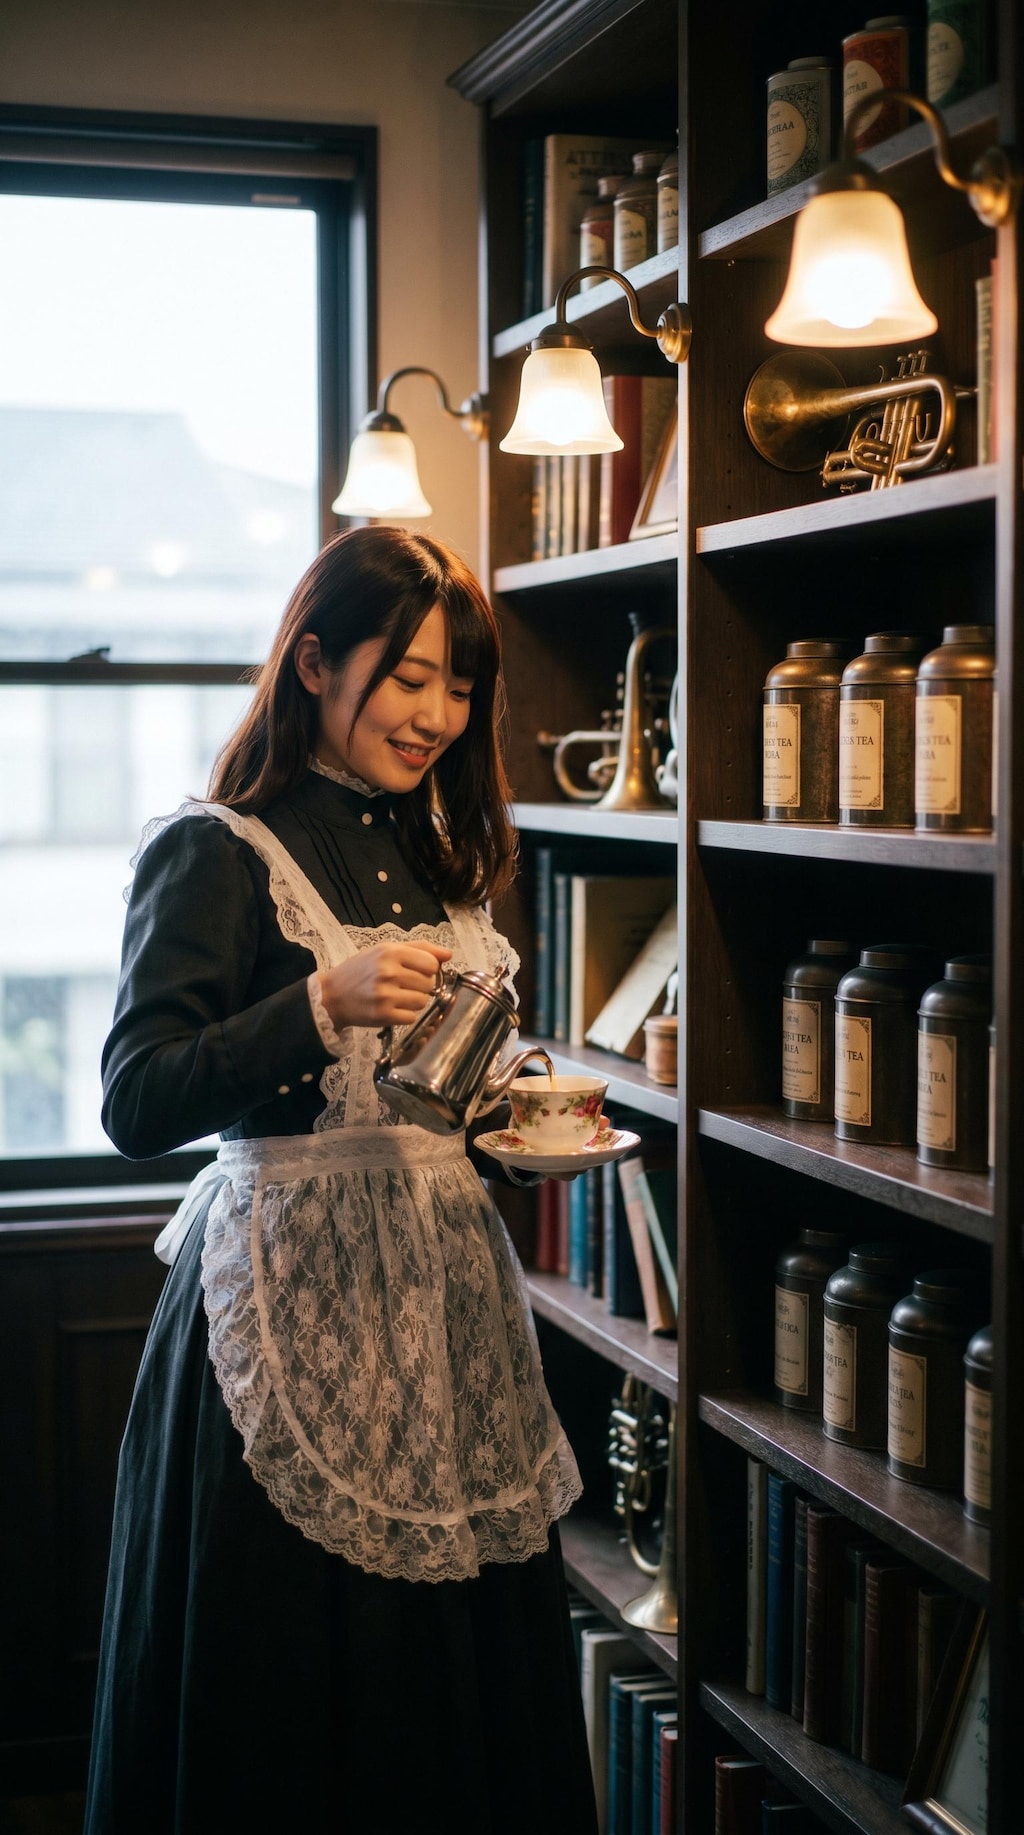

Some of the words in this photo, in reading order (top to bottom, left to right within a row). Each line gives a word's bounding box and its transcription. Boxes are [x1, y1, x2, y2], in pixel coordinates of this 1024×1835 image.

[777, 737, 792, 747] TEA
[857, 736, 874, 746] TEA
[933, 735, 951, 746] TEA
[797, 1033, 812, 1045] TEA
[847, 1050, 864, 1063] TEA
[929, 1071, 946, 1083] TEA
[834, 1355, 848, 1369] TEA
[899, 1386, 915, 1401] TEA
